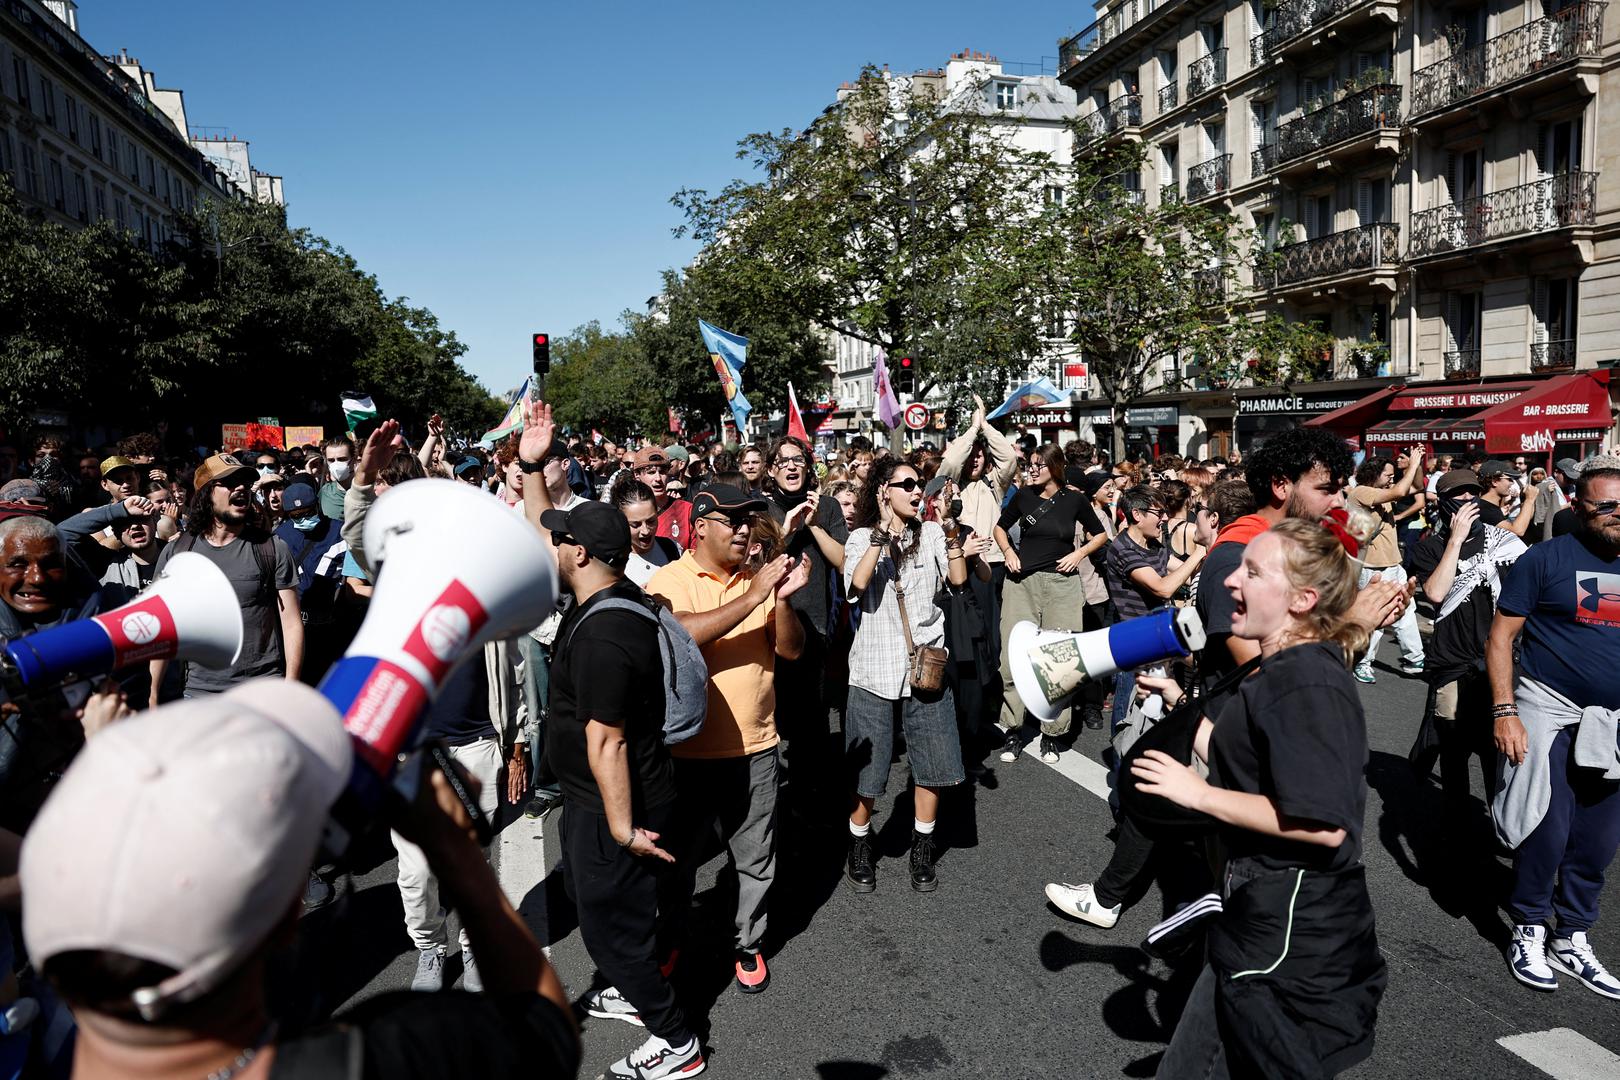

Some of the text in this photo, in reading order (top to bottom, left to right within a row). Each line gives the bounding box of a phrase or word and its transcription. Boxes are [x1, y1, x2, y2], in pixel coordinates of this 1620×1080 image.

[1240, 398, 1303, 412] PHARMACIE
[1315, 401, 1337, 409] CIRQUE
[1414, 393, 1522, 408] BRASSERIE LA RENAISSAN
[1523, 406, 1540, 416] BAR
[1545, 404, 1589, 415] BRASSERIE
[1366, 431, 1486, 442] BRASSERIE LA RENA
